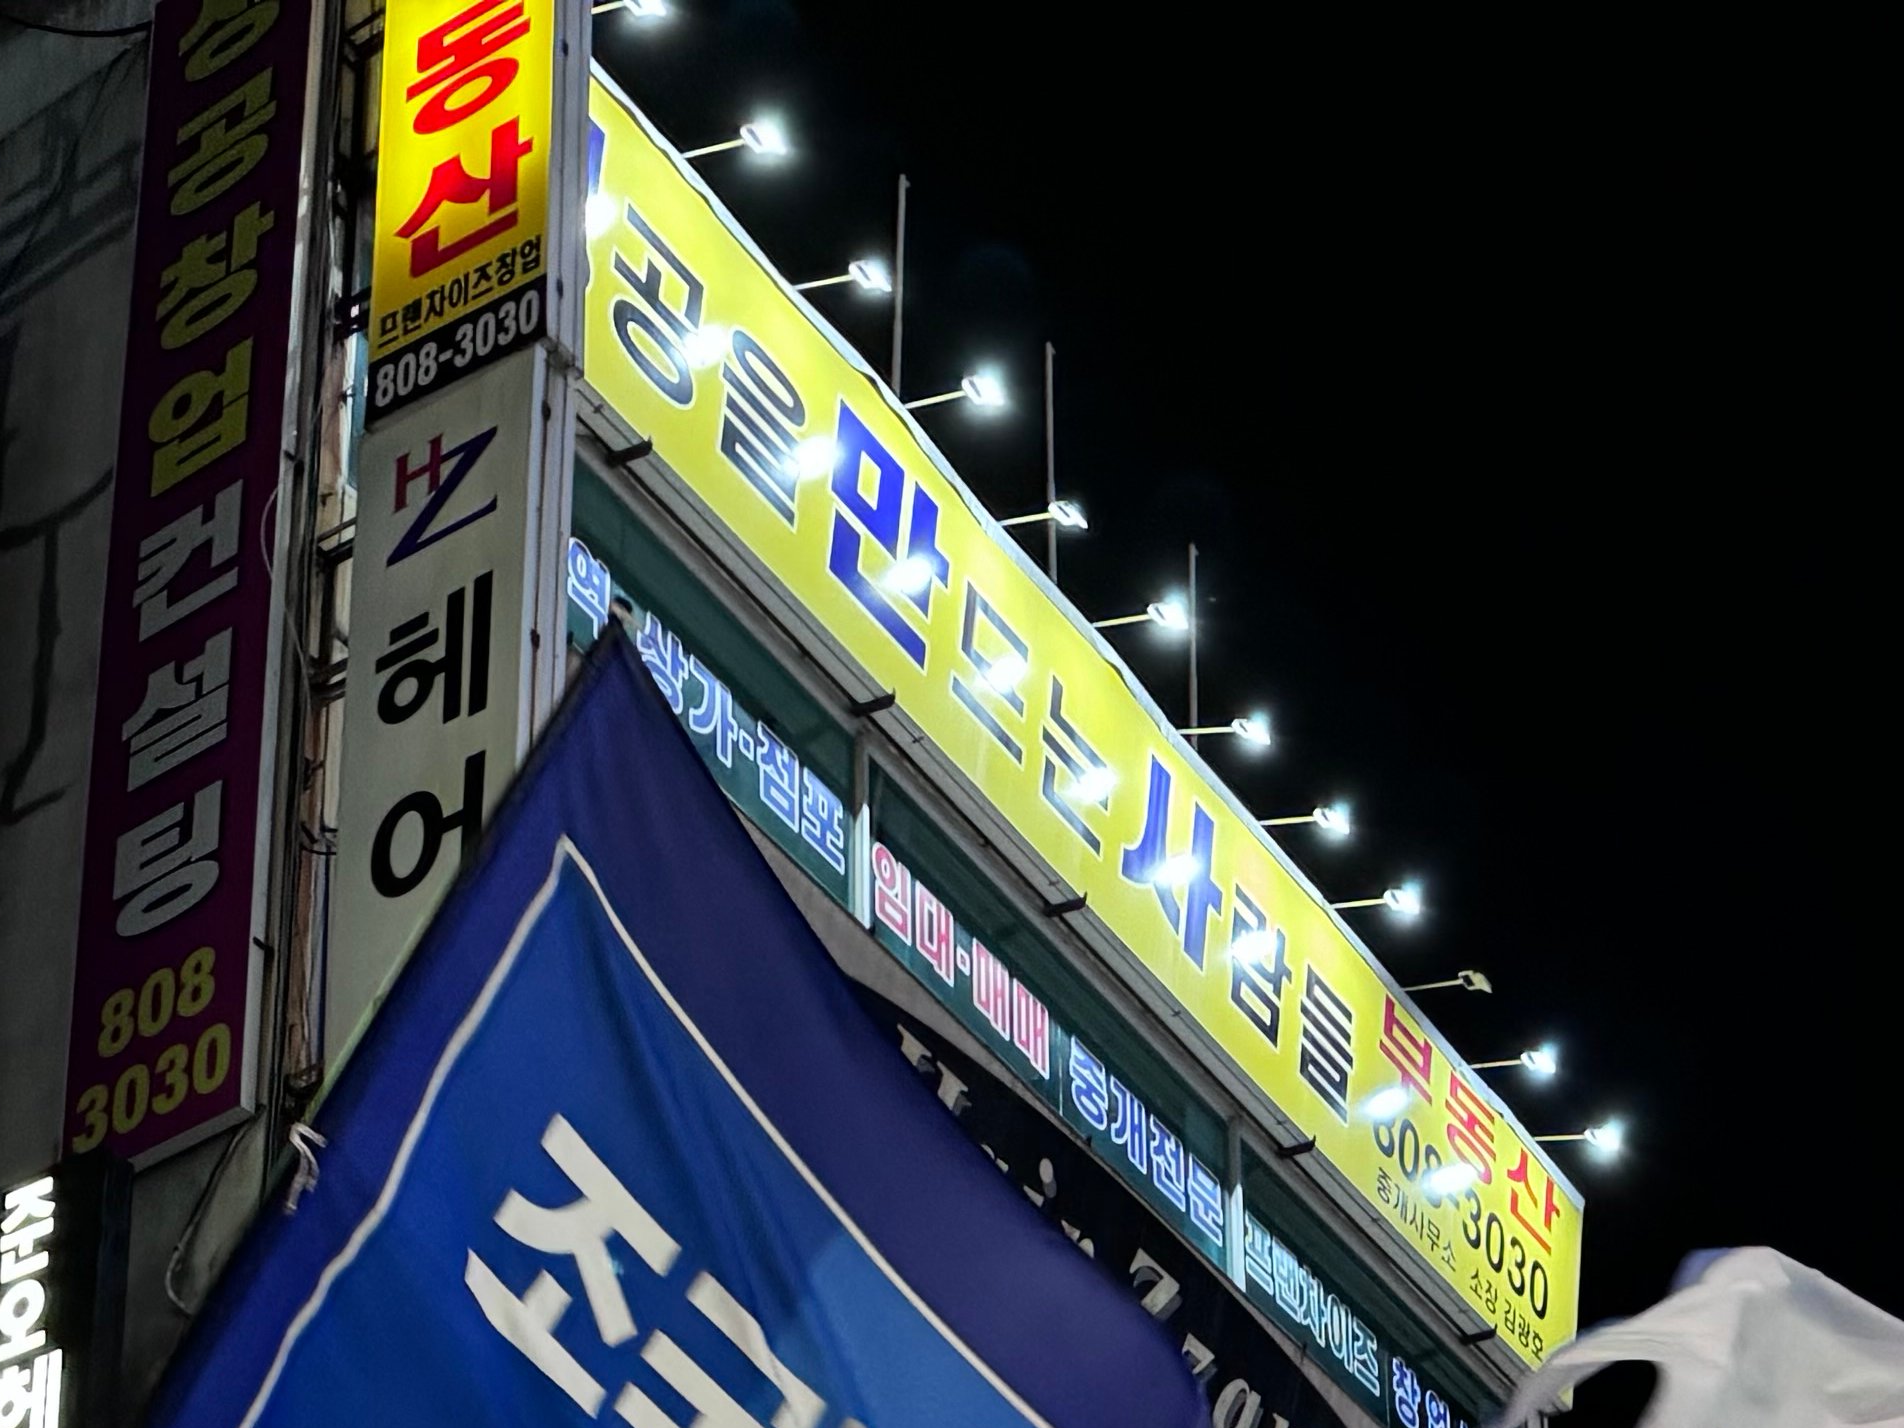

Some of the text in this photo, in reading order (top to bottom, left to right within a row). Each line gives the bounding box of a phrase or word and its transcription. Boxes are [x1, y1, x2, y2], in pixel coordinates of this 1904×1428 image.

[374, 289, 541, 408] 808-3030
[587, 115, 807, 531] 공을
[1122, 755, 1356, 1126] 사람들
[72, 1022, 232, 1154] 3030
[96, 946, 217, 1058] 808
[1066, 1034, 1226, 1254] 중개전문
[1371, 1116, 1550, 1322] 808-3030
[1377, 991, 1560, 1257] 부동산
